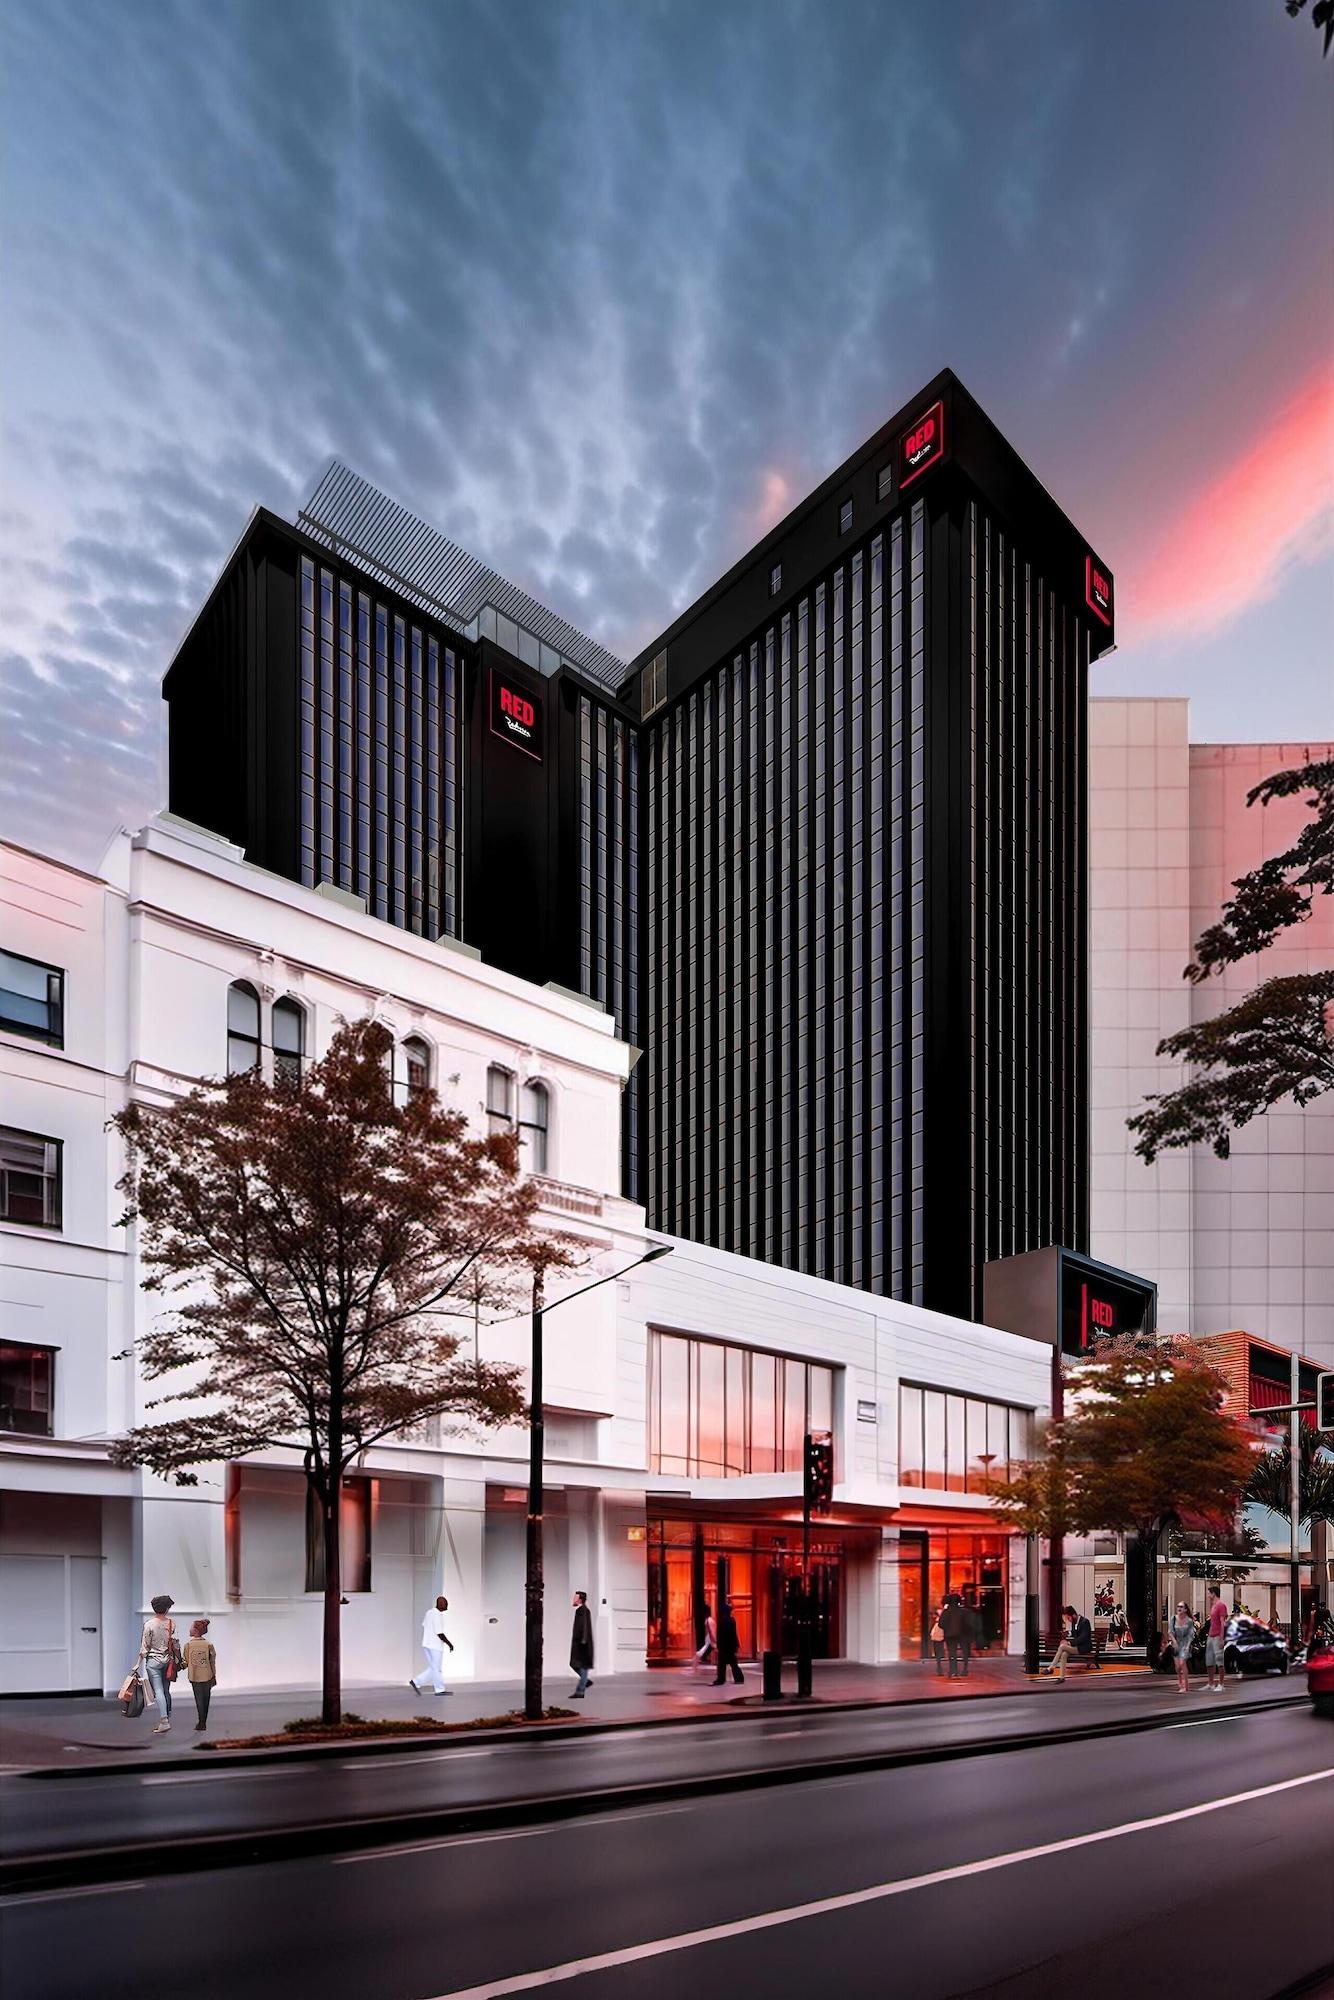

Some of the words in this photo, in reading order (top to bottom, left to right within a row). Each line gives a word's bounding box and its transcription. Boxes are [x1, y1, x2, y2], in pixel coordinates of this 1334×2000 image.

[906, 419, 935, 459] RED
[501, 687, 534, 727] RED
[1092, 1299, 1113, 1327] RED
